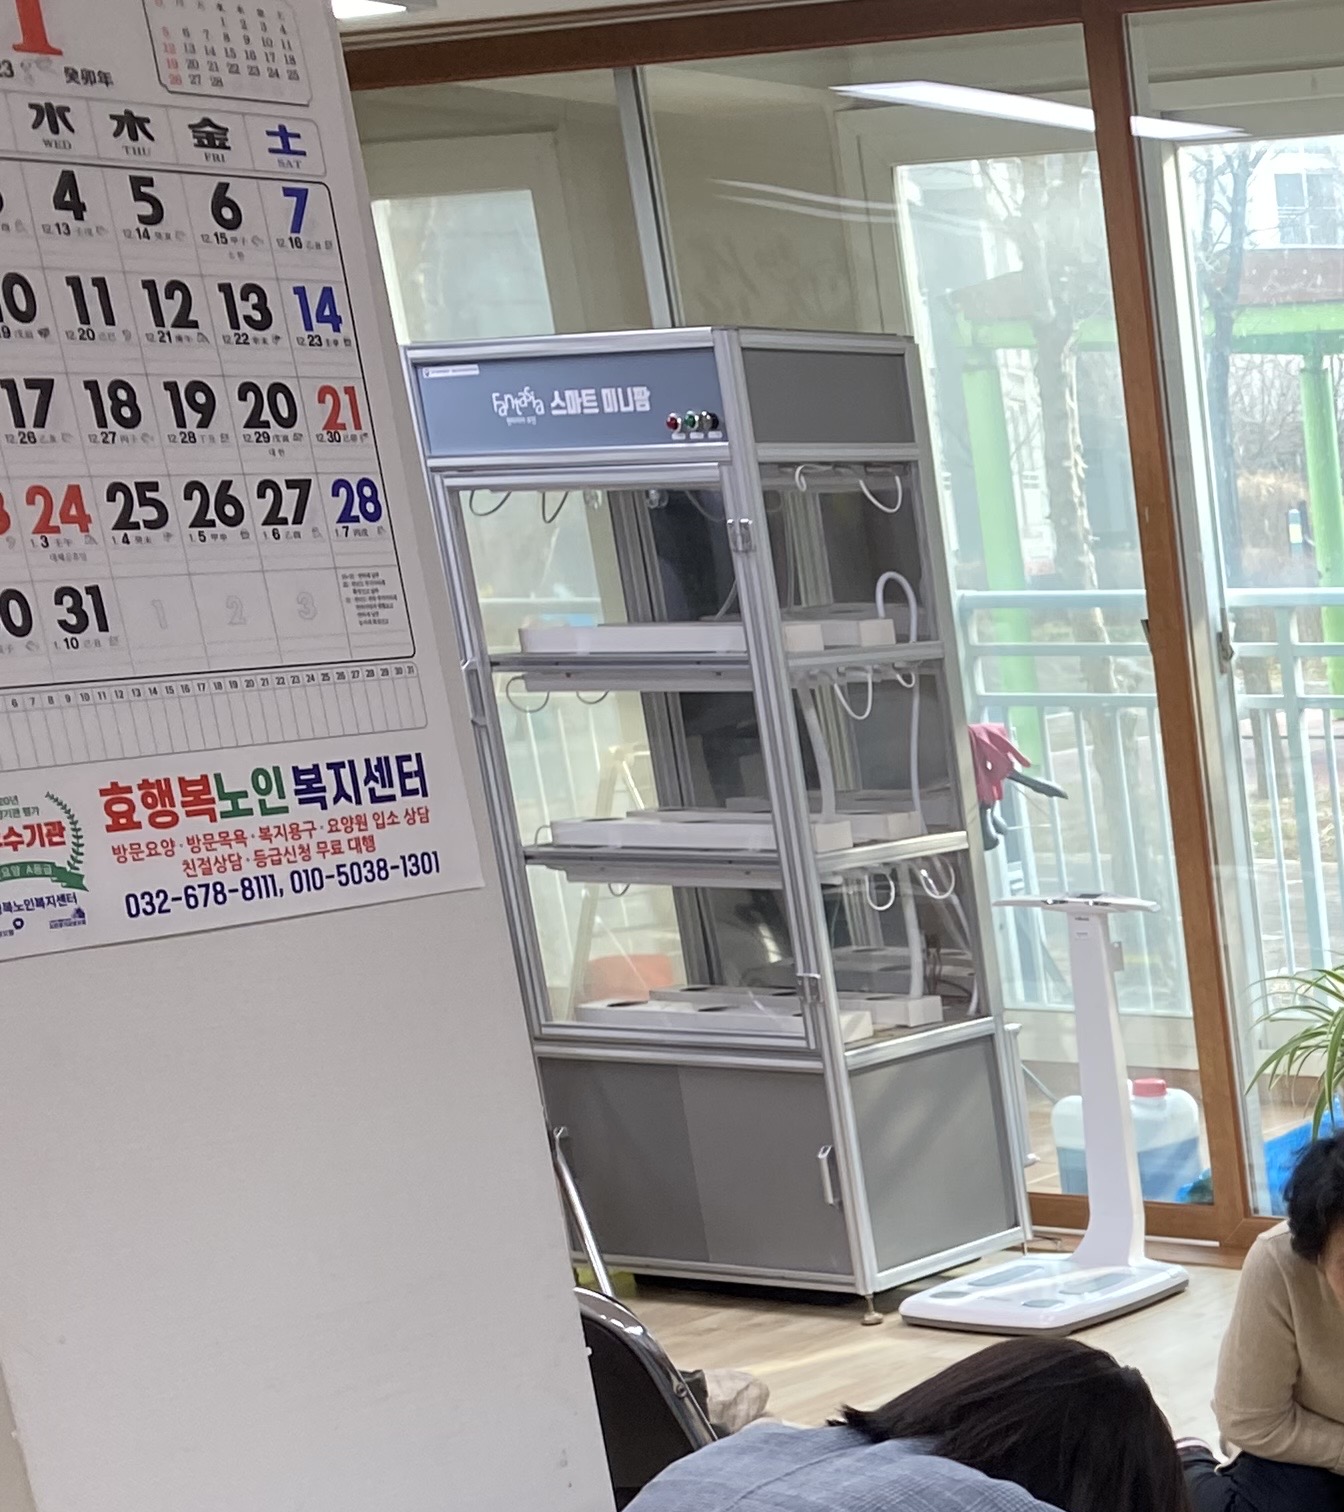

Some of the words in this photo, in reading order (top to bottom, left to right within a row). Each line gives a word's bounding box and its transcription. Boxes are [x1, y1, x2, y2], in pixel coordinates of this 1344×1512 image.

[28, 102, 75, 135] 水
[109, 109, 155, 142] 木
[187, 117, 232, 151] 金
[265, 124, 307, 156] 土
[42, 138, 72, 151] WED
[123, 145, 151, 158] THU
[205, 152, 226, 164] FRI
[278, 158, 302, 170] SAT
[52, 169, 87, 221] 4
[129, 174, 165, 226] 5
[211, 181, 242, 231] 6
[282, 186, 309, 234] 7
[0, 271, 37, 324] 0
[65, 275, 116, 327] 11
[141, 278, 199, 329] 12
[217, 282, 273, 331] 13
[292, 286, 342, 334] 14
[0, 378, 55, 428] 17
[83, 378, 142, 430] 18
[163, 379, 217, 429] 19
[237, 381, 298, 430] 20
[317, 384, 362, 431] 21
[551, 388, 600, 416] 스마트
[25, 484, 92, 535] 24
[106, 481, 169, 531] 25
[183, 479, 245, 528] 26
[257, 478, 312, 526] 27
[331, 477, 382, 524] 28
[53, 584, 111, 635] 31
[99, 765, 289, 833] 효행복노인
[292, 752, 429, 811] 복지센터
[112, 838, 176, 865] 방문요양
[186, 829, 248, 854] 방문목욕
[258, 820, 317, 844] 복지용구
[327, 813, 369, 835] 요양원
[372, 809, 401, 830] 입소
[403, 805, 431, 825] 상담
[182, 852, 243, 878] 친절상담
[253, 844, 311, 869] 등급신청
[316, 839, 346, 860] 무료
[347, 834, 377, 855] 대행
[125, 873, 285, 919] 032-678-8111,
[290, 850, 440, 895] 010-5038-1301
